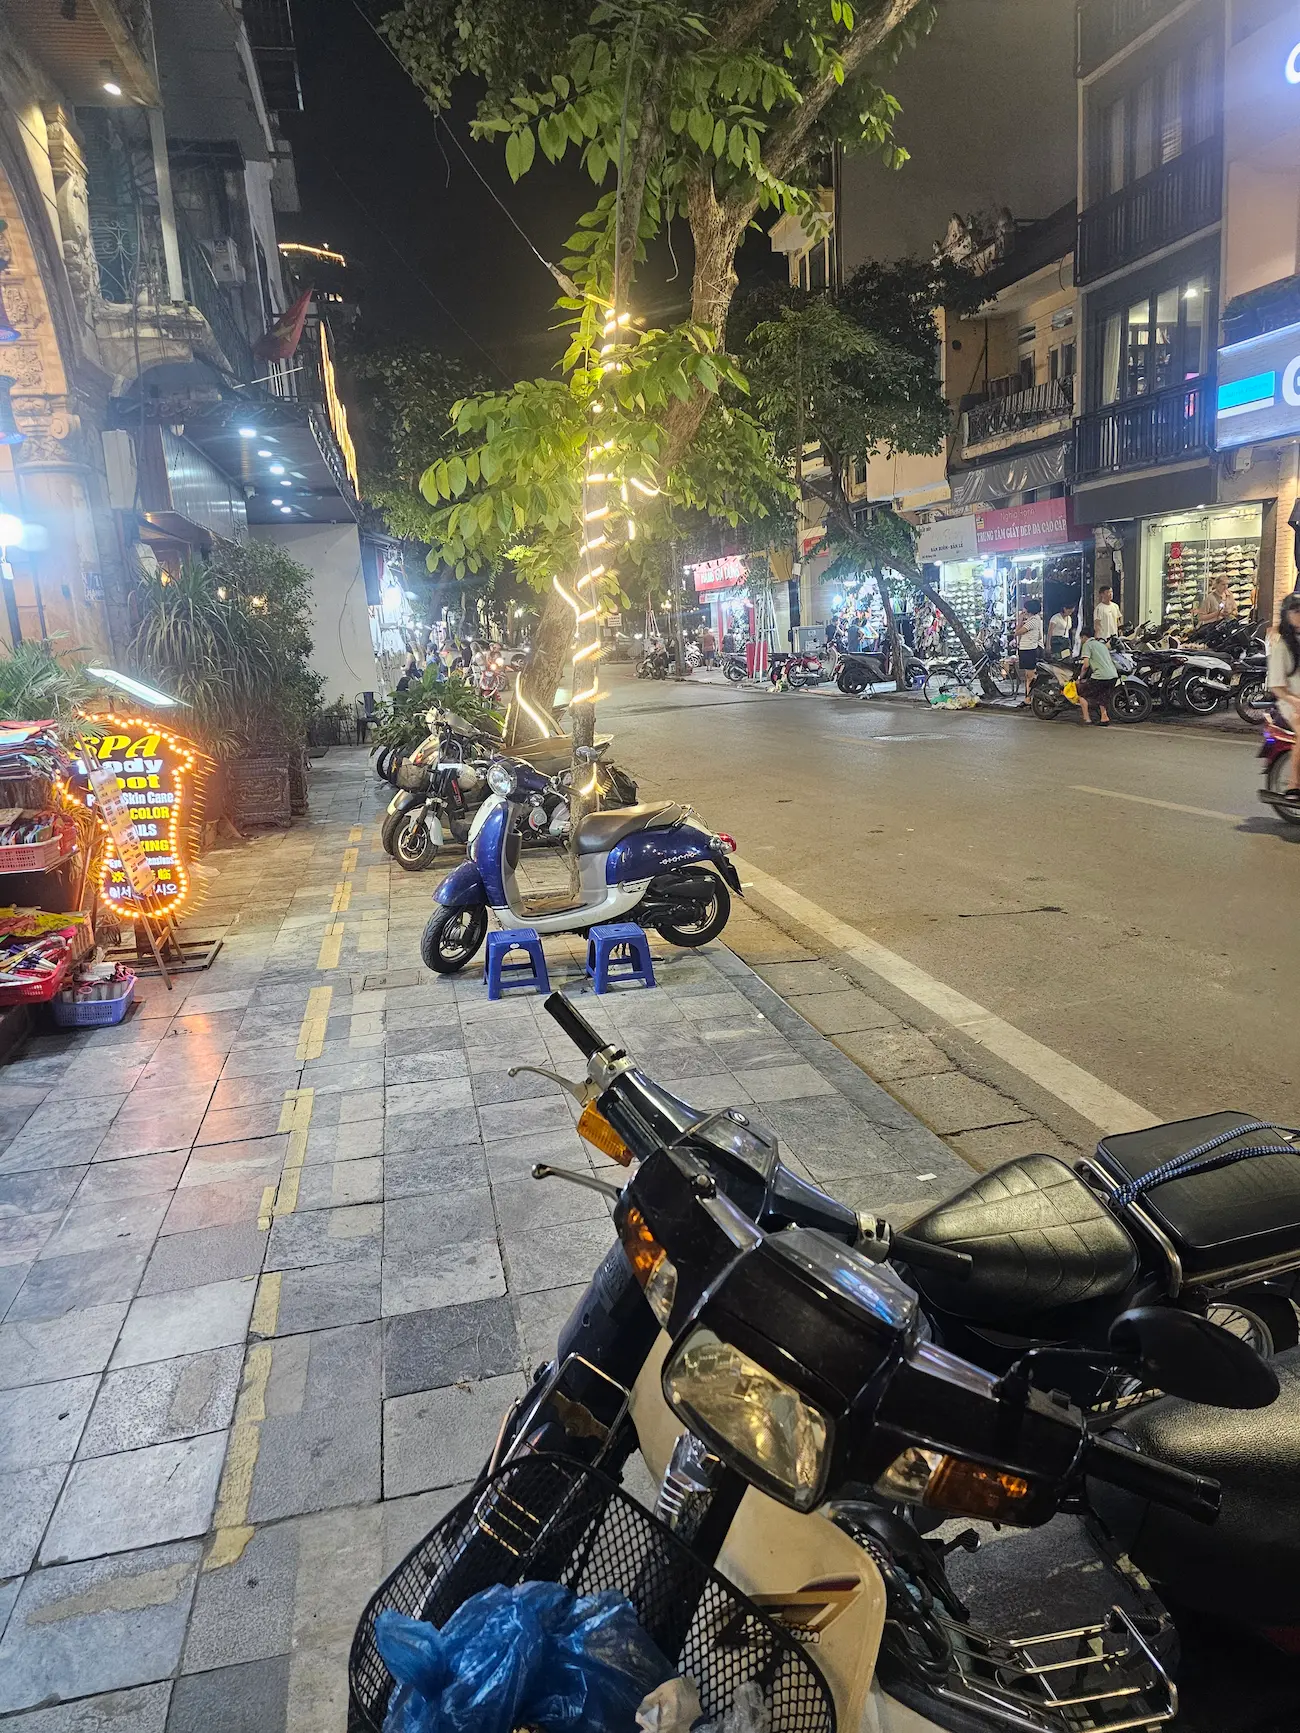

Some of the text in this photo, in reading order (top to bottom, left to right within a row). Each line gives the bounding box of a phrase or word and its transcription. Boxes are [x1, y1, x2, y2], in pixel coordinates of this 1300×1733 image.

[976, 530, 994, 543] TRUNG
[1032, 524, 1042, 535] DA
[1042, 520, 1054, 533] CAO
[1054, 515, 1067, 531] CẤP
[69, 735, 161, 760] SPA
[121, 792, 147, 805] Skin
[129, 806, 170, 820] COLOR
